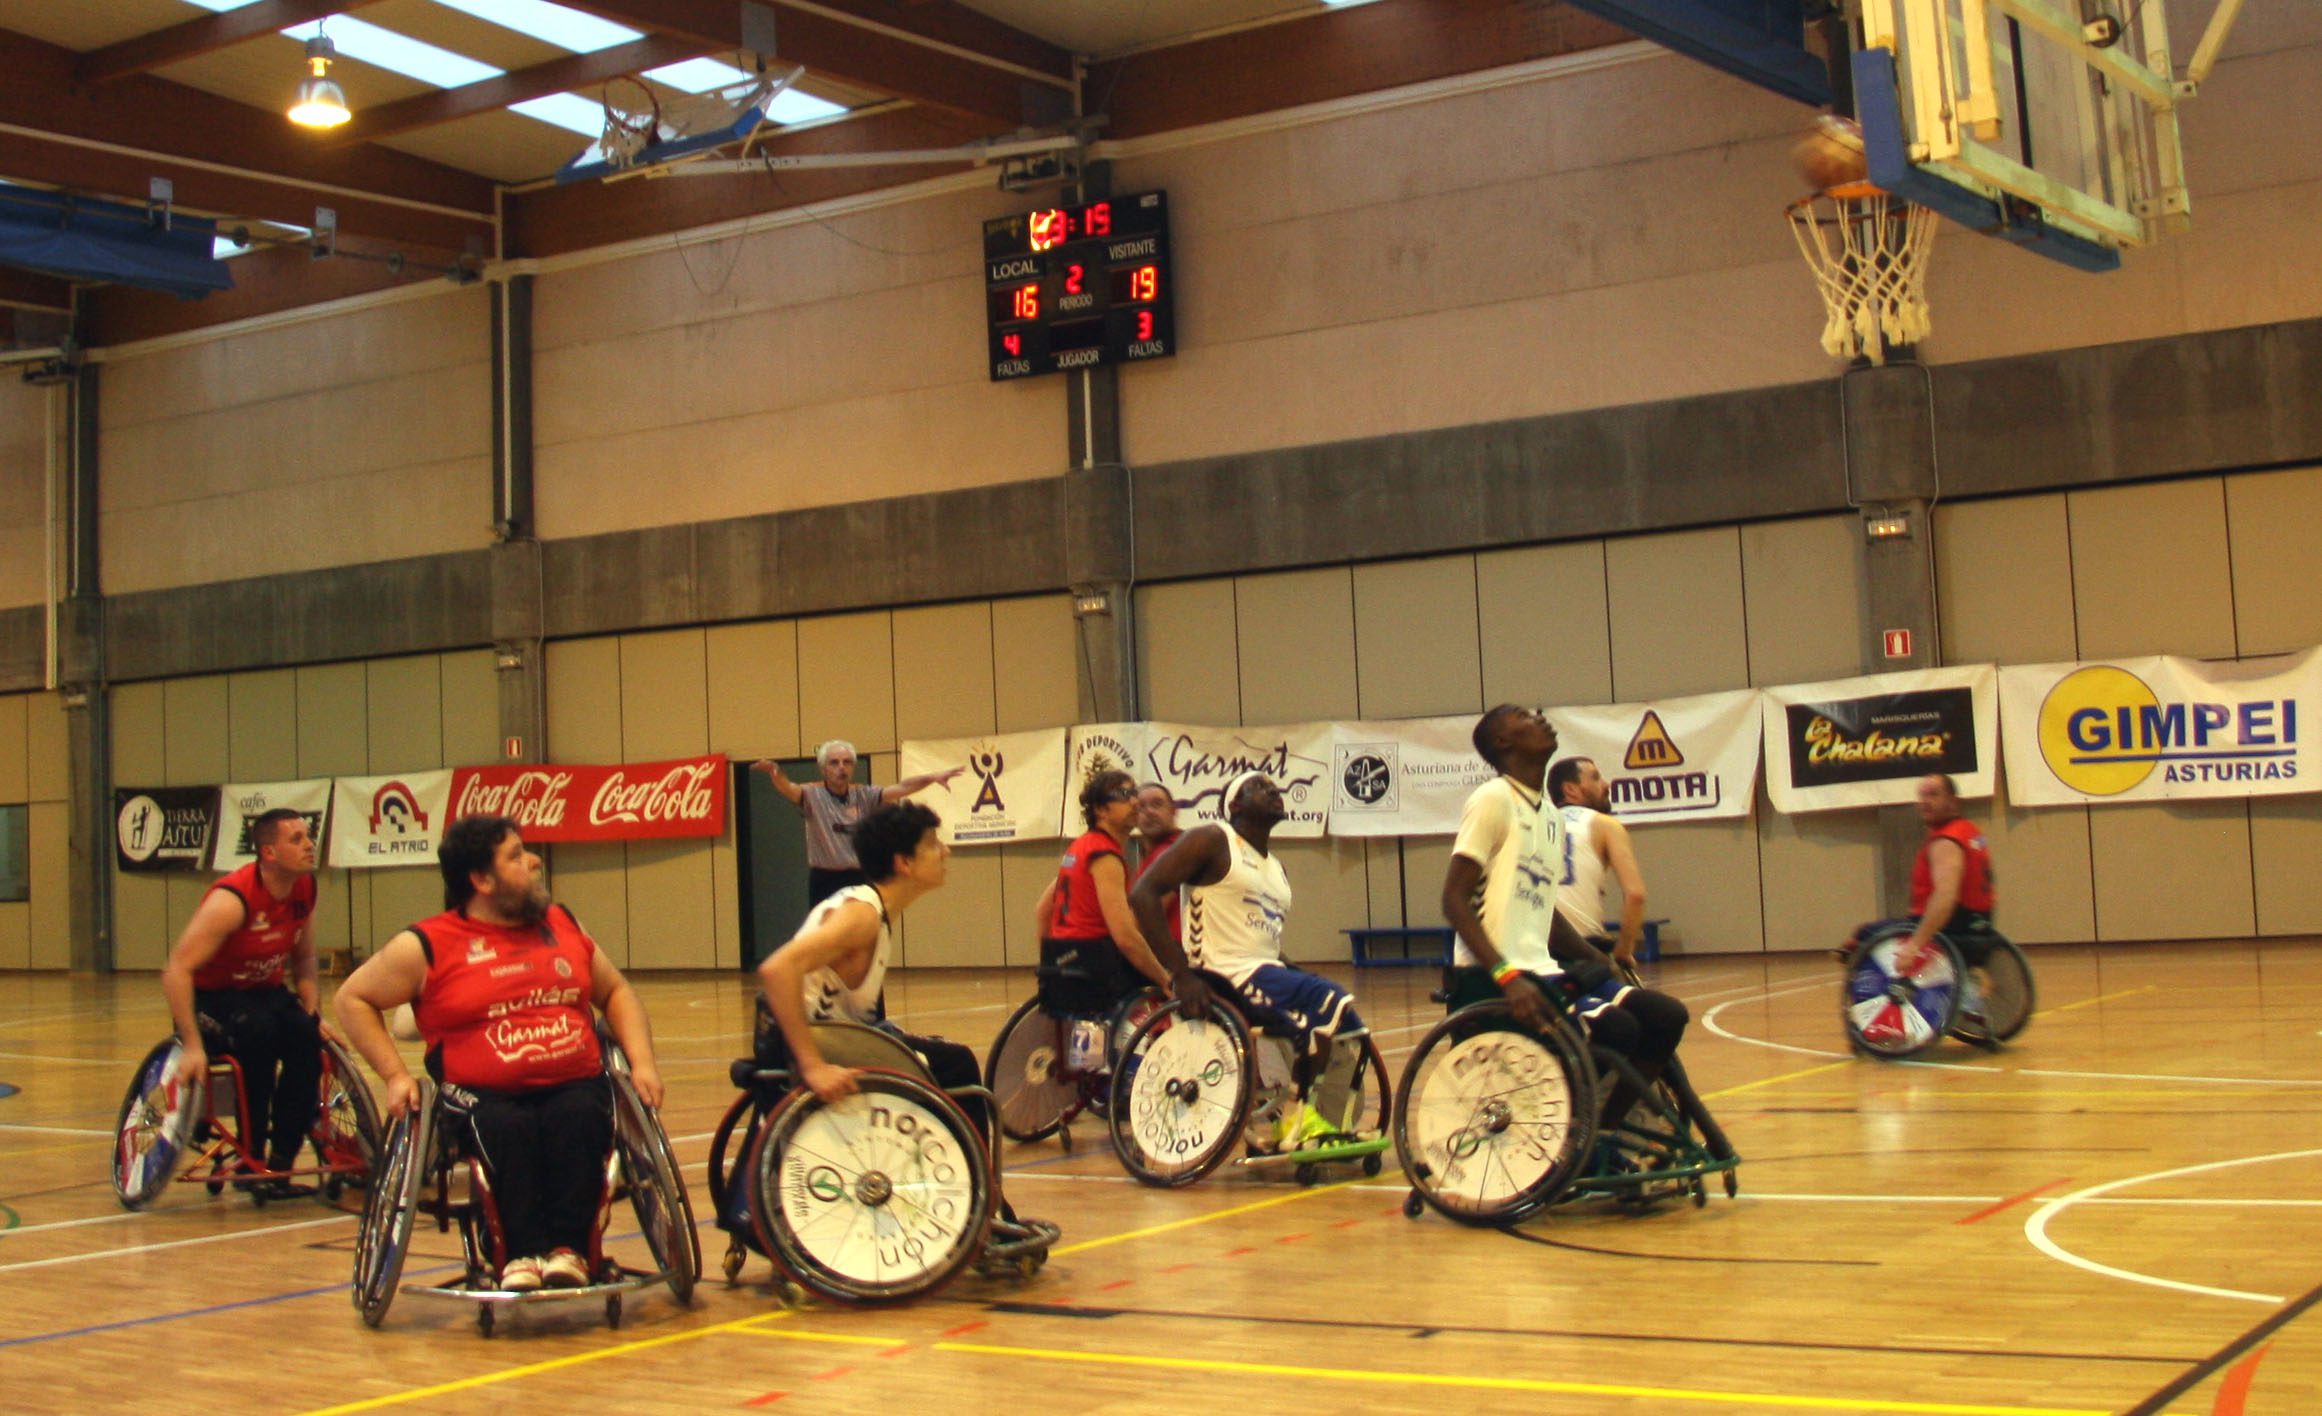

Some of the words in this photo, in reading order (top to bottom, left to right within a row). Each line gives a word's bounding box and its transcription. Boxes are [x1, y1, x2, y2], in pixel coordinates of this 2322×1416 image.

[1108, 238, 1156, 260] VISITANTE
[992, 259, 1039, 281] LOCAL
[1065, 264, 1084, 294] 2
[1131, 265, 1158, 300] 19
[1013, 283, 1039, 319] 16
[1136, 310, 1153, 340] 3
[1003, 333, 1021, 356] 4
[1128, 340, 1164, 358] FALTAS
[997, 359, 1031, 377] FALTAS
[1056, 350, 1100, 369] JUGADOR
[1804, 714, 1833, 743] La
[2066, 699, 2297, 752] GIMPEI
[1086, 735, 1135, 769] DEPORTIVO
[1168, 734, 1290, 785] Garmat
[1808, 730, 1945, 765] Chalana
[1401, 762, 1462, 776] Asturiana
[1464, 759, 1480, 772] de
[2164, 759, 2298, 784] ASTURIAS
[589, 762, 716, 826] Coca-Cola
[368, 842, 386, 854] EL
[390, 839, 429, 853] ATRIO
